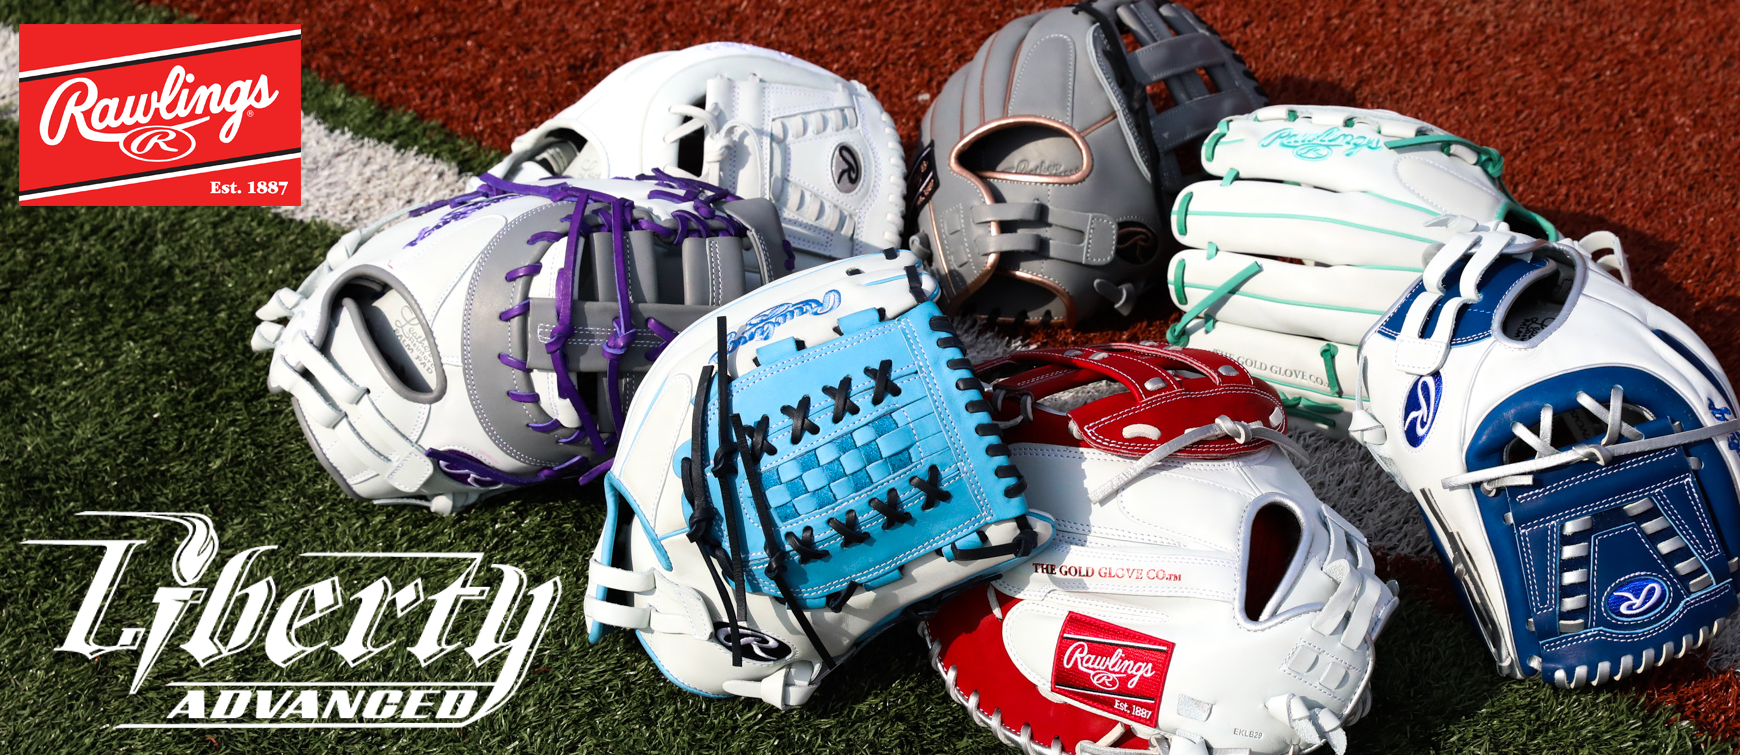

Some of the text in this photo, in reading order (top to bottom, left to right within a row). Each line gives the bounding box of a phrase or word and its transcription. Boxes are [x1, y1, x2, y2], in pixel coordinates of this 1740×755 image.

[1259, 127, 1384, 157] Rawlings
[1237, 356, 1268, 372] GOLD
[1270, 364, 1308, 381] GLOVE
[1032, 562, 1057, 576] THE
[1059, 564, 1095, 578] GOLD
[1098, 566, 1144, 580] GLOVE
[1063, 641, 1155, 689] Rawlings
[1114, 699, 1153, 720] Est. 1887
[1233, 727, 1263, 740] EKLB29
